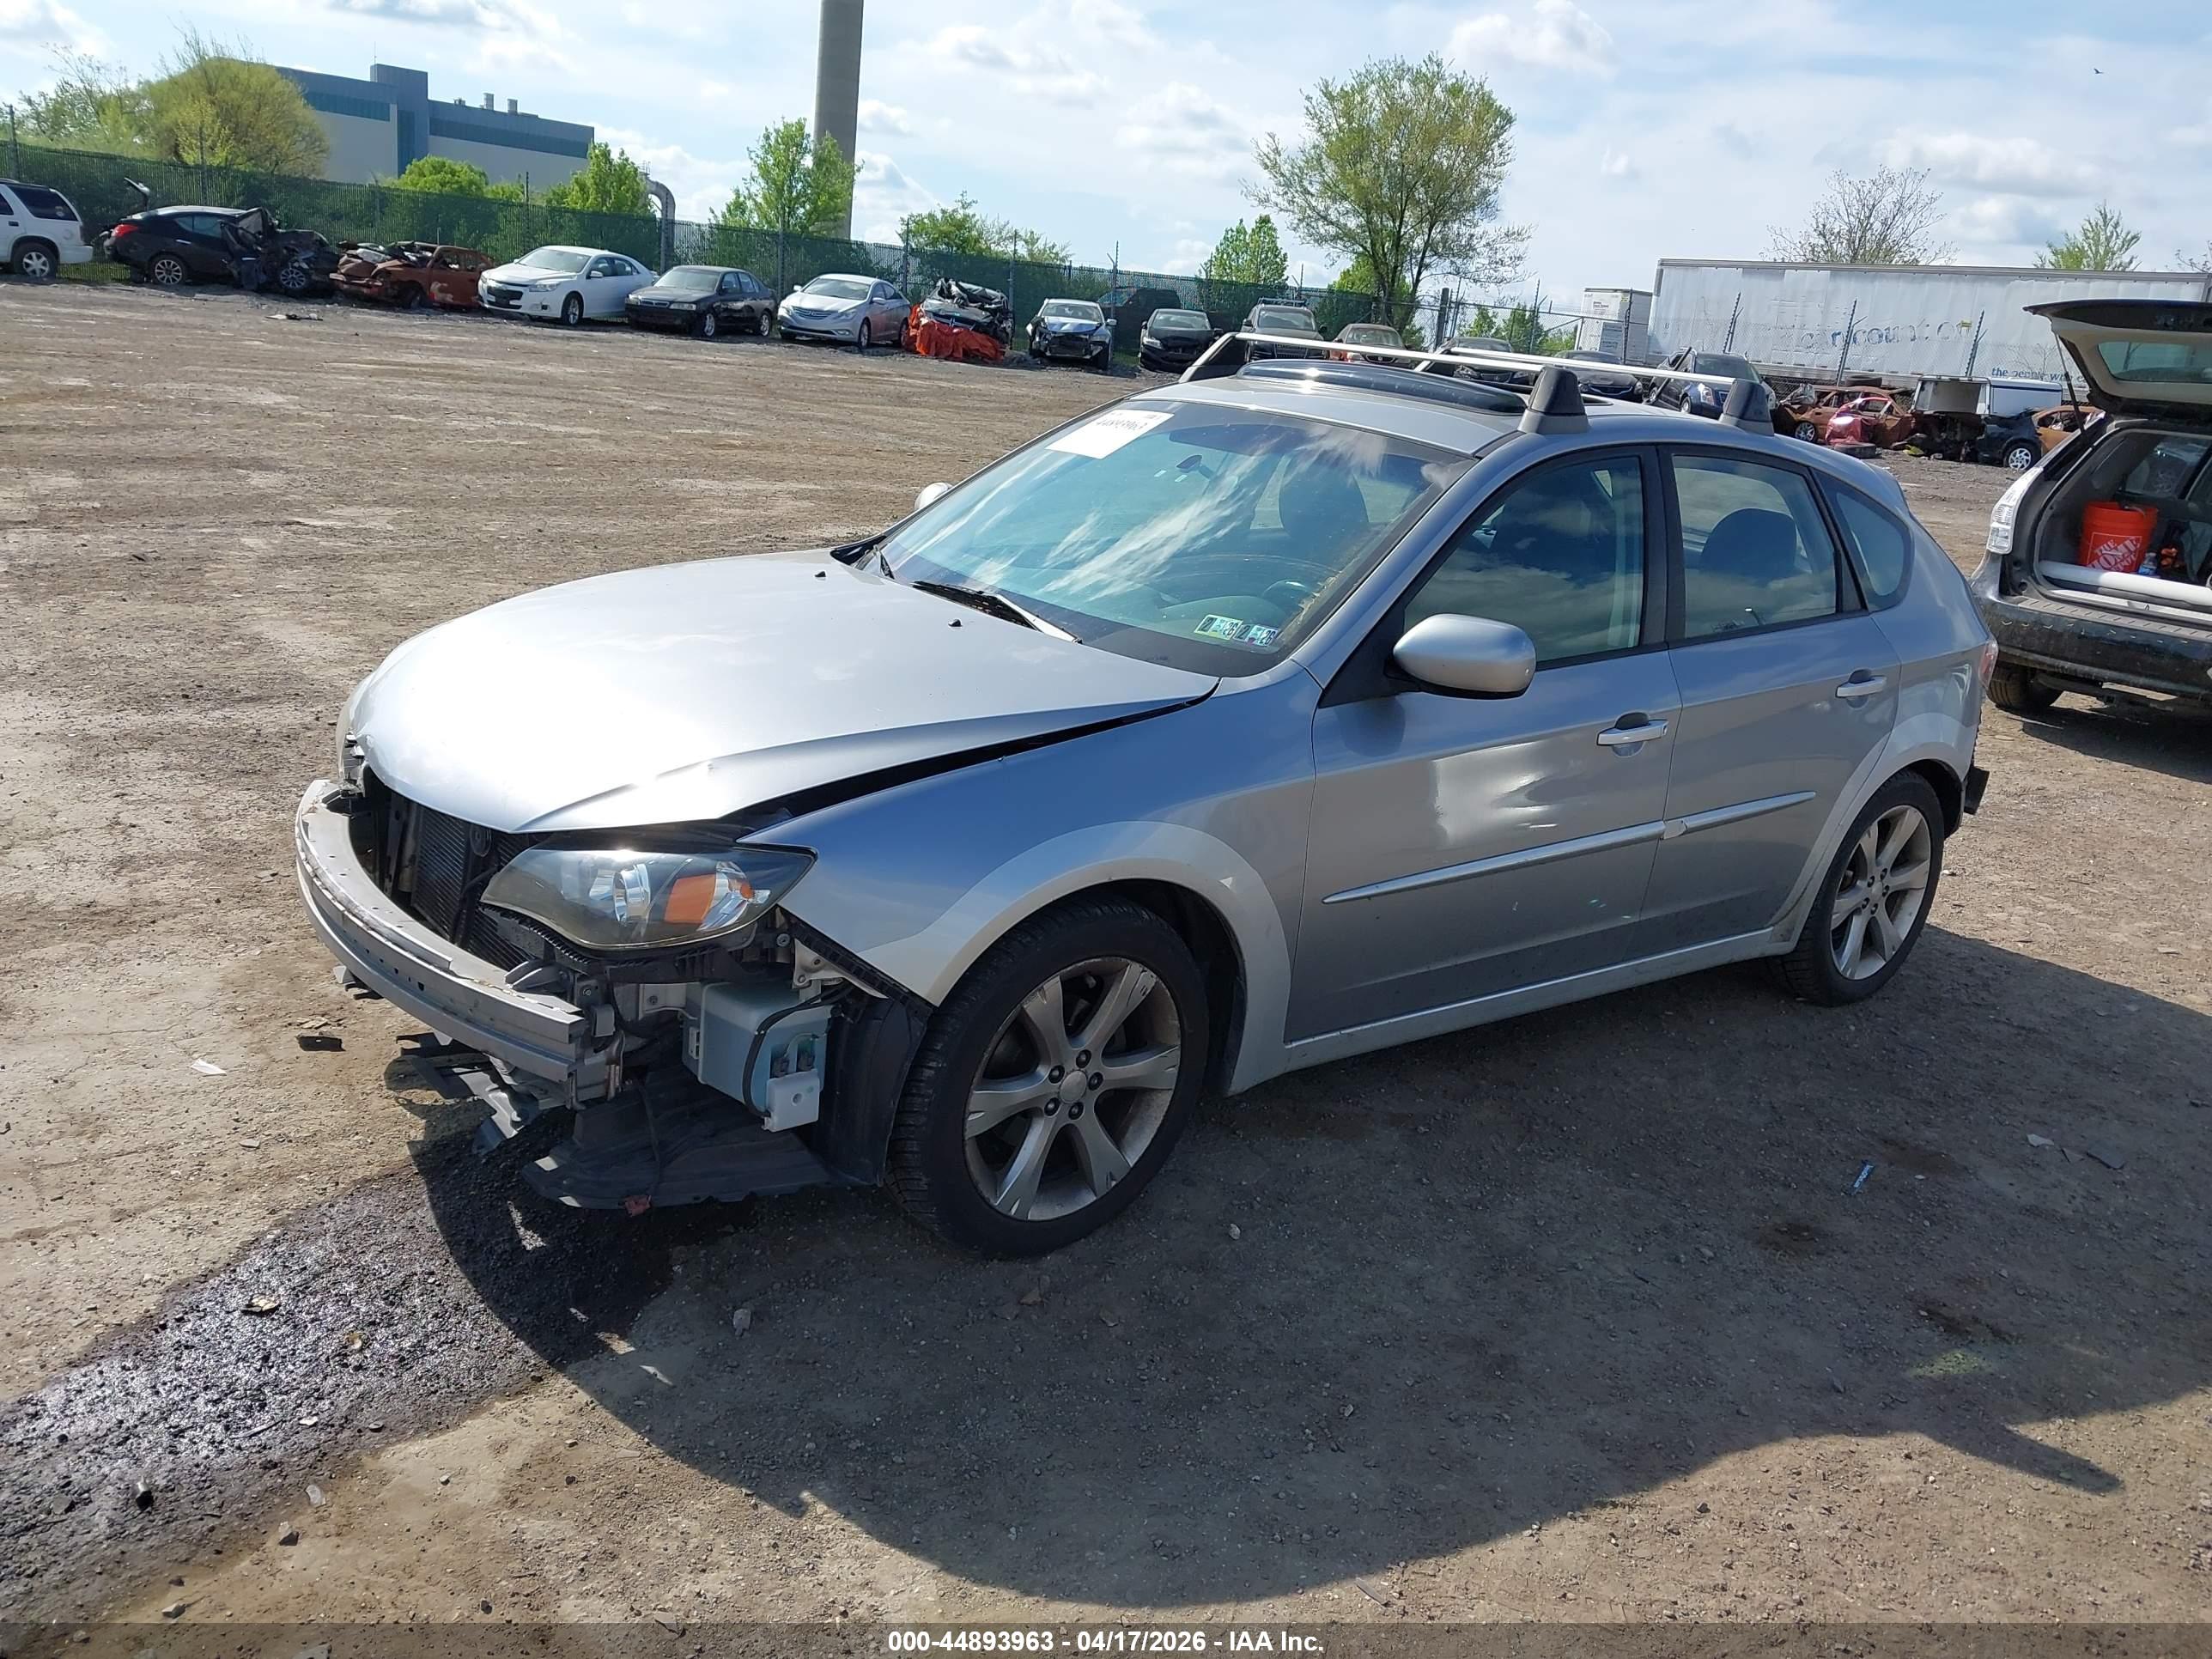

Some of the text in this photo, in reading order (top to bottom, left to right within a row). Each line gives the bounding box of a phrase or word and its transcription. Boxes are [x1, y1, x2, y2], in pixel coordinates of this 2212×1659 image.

[1991, 368, 2008, 377] the
[1202, 617, 1214, 632] 2
[1237, 625, 1251, 640] 2
[1259, 629, 1276, 645] 26
